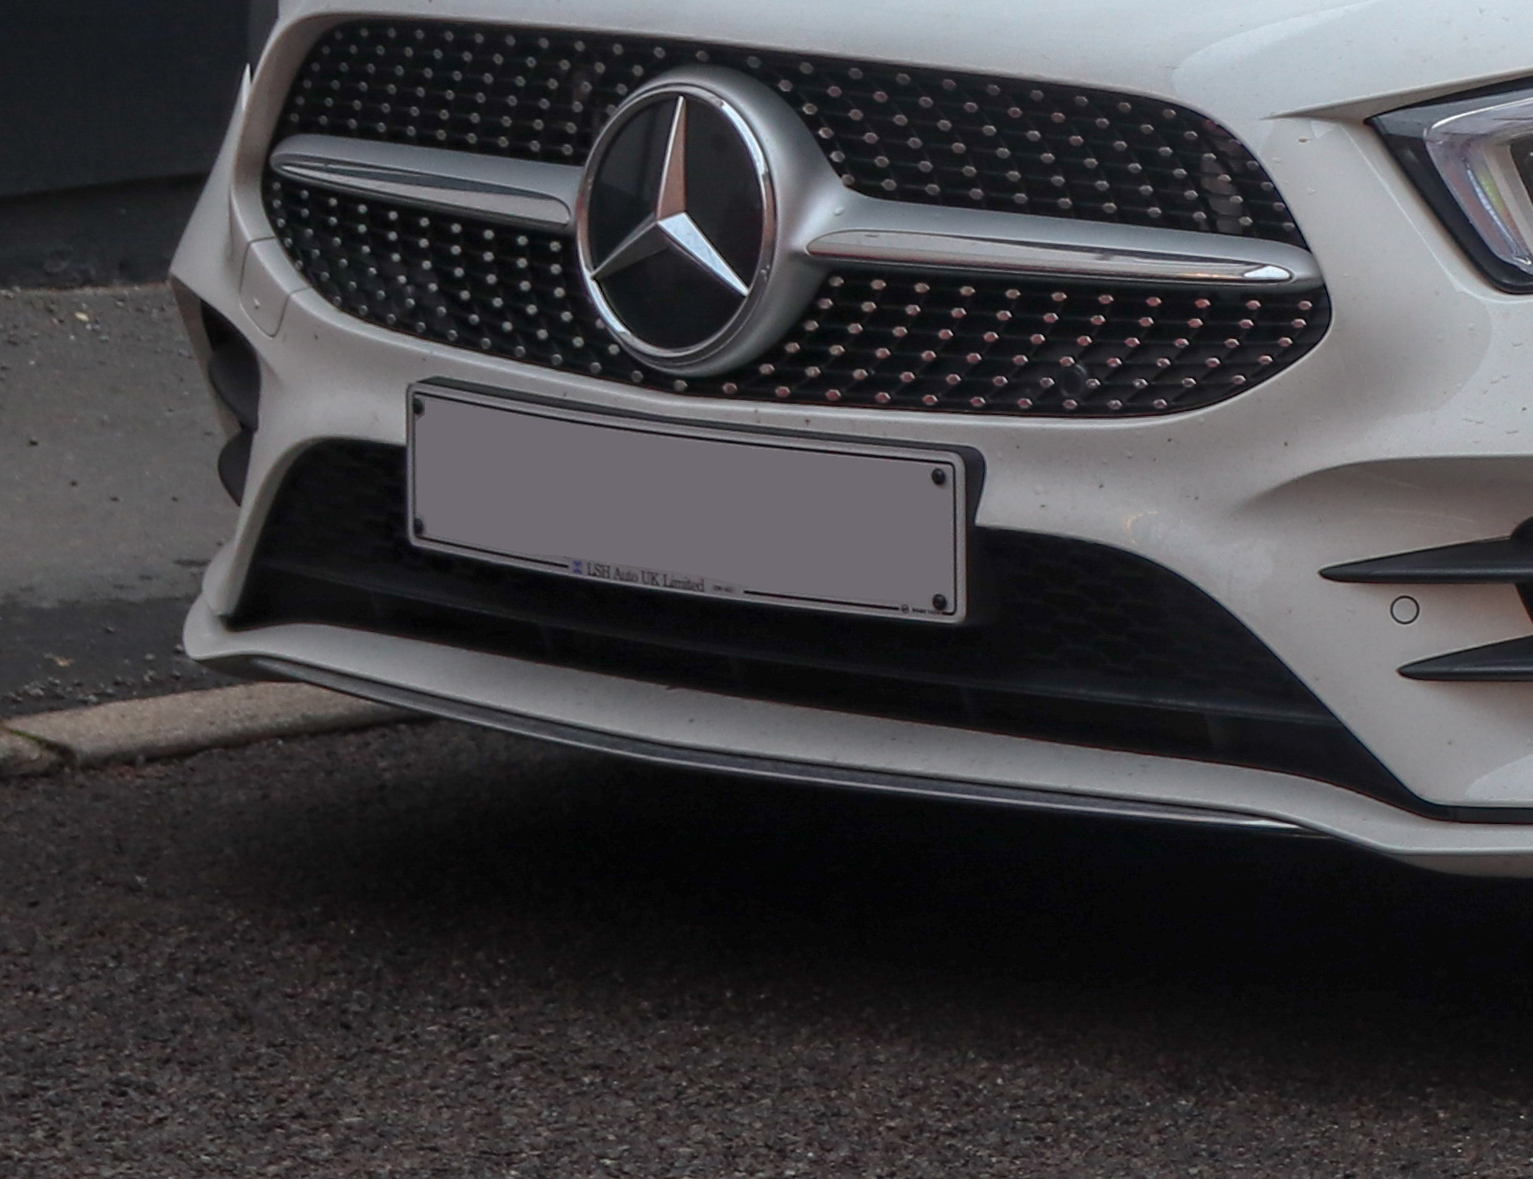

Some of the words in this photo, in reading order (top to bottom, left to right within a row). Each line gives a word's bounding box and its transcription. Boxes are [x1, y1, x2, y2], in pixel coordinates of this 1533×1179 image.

[587, 562, 611, 579] LSH
[614, 567, 638, 583] Auto
[641, 571, 660, 587] UK
[662, 574, 705, 592] Limited
